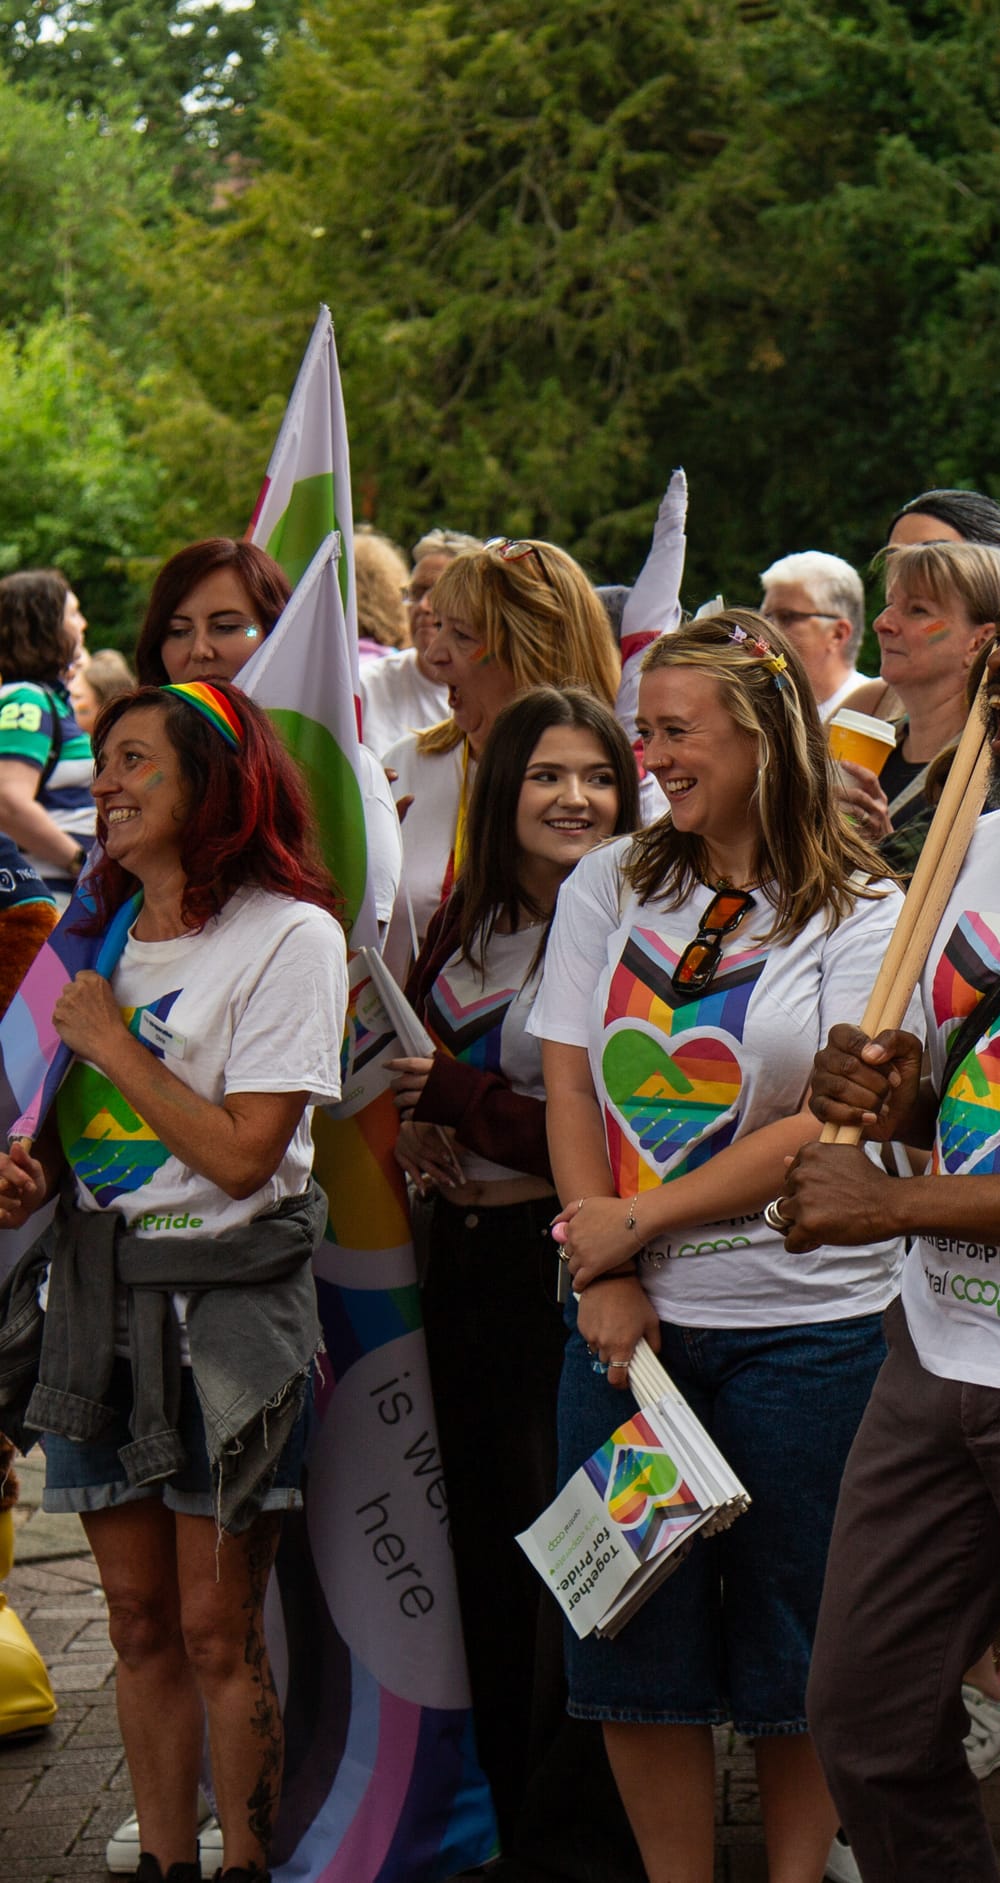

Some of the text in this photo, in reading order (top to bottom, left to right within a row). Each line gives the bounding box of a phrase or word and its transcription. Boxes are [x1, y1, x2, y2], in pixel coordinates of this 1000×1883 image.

[369, 1371, 413, 1426] is
[355, 1491, 435, 1619] here
[556, 1526, 611, 1592] for Pride.
[569, 1544, 620, 1611] Together
